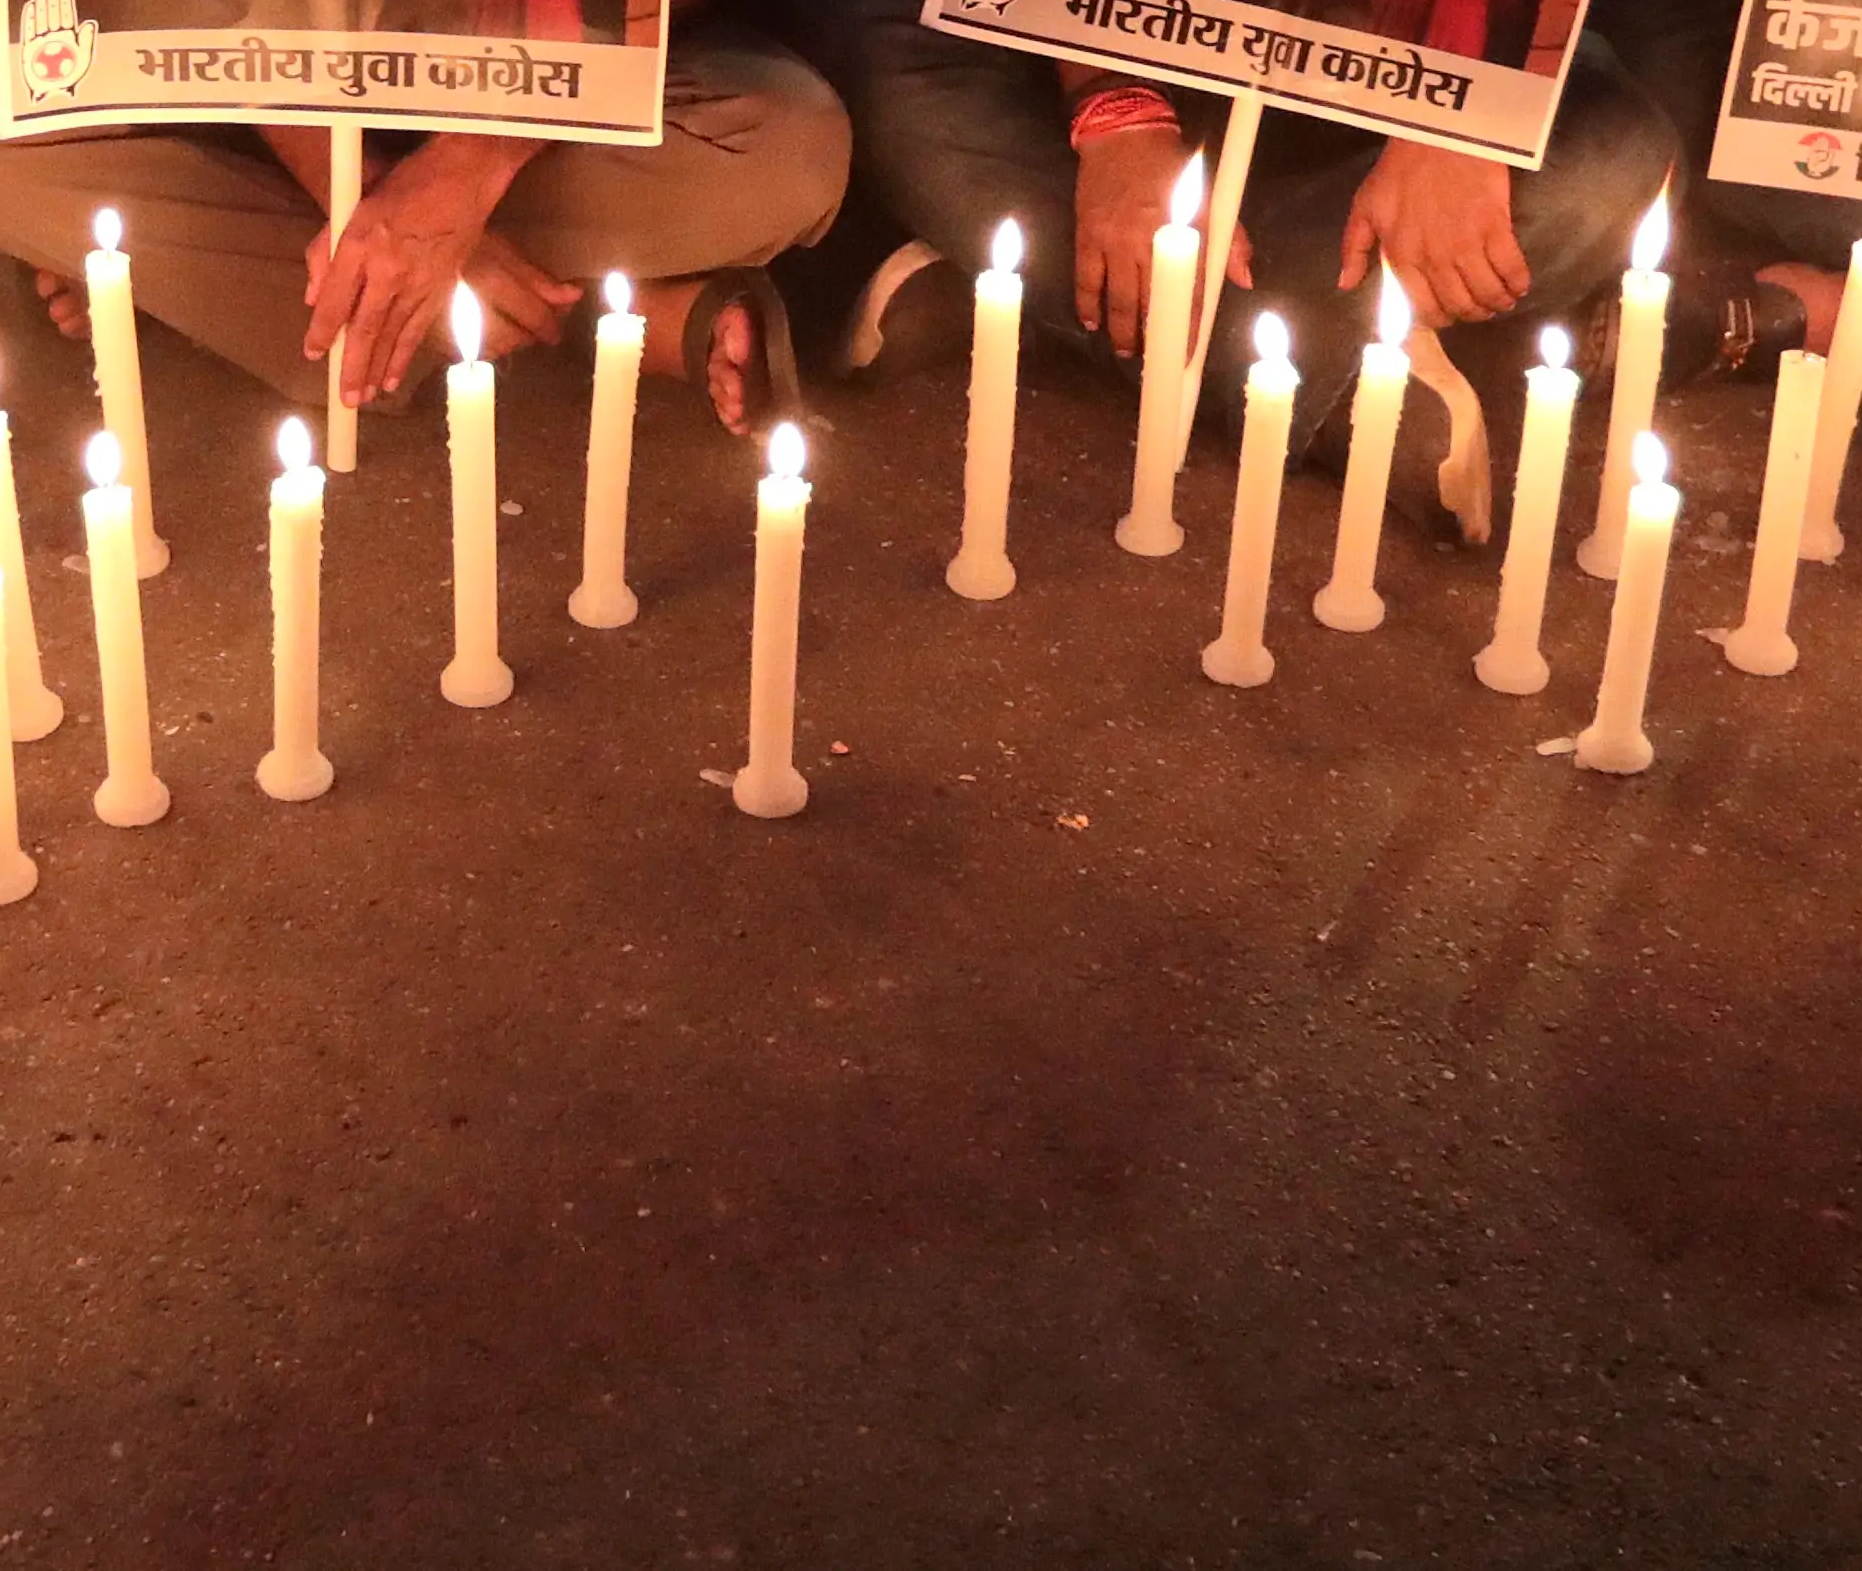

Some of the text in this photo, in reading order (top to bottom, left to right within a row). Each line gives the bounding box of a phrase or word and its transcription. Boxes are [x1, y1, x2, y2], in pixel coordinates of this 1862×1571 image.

[137, 37, 583, 99] भारतीय युवा कांग्रेस
[1240, 18, 1316, 77] युवा
[1319, 43, 1472, 112] कांग्रेस
[1749, 63, 1856, 115] दिल्ली
